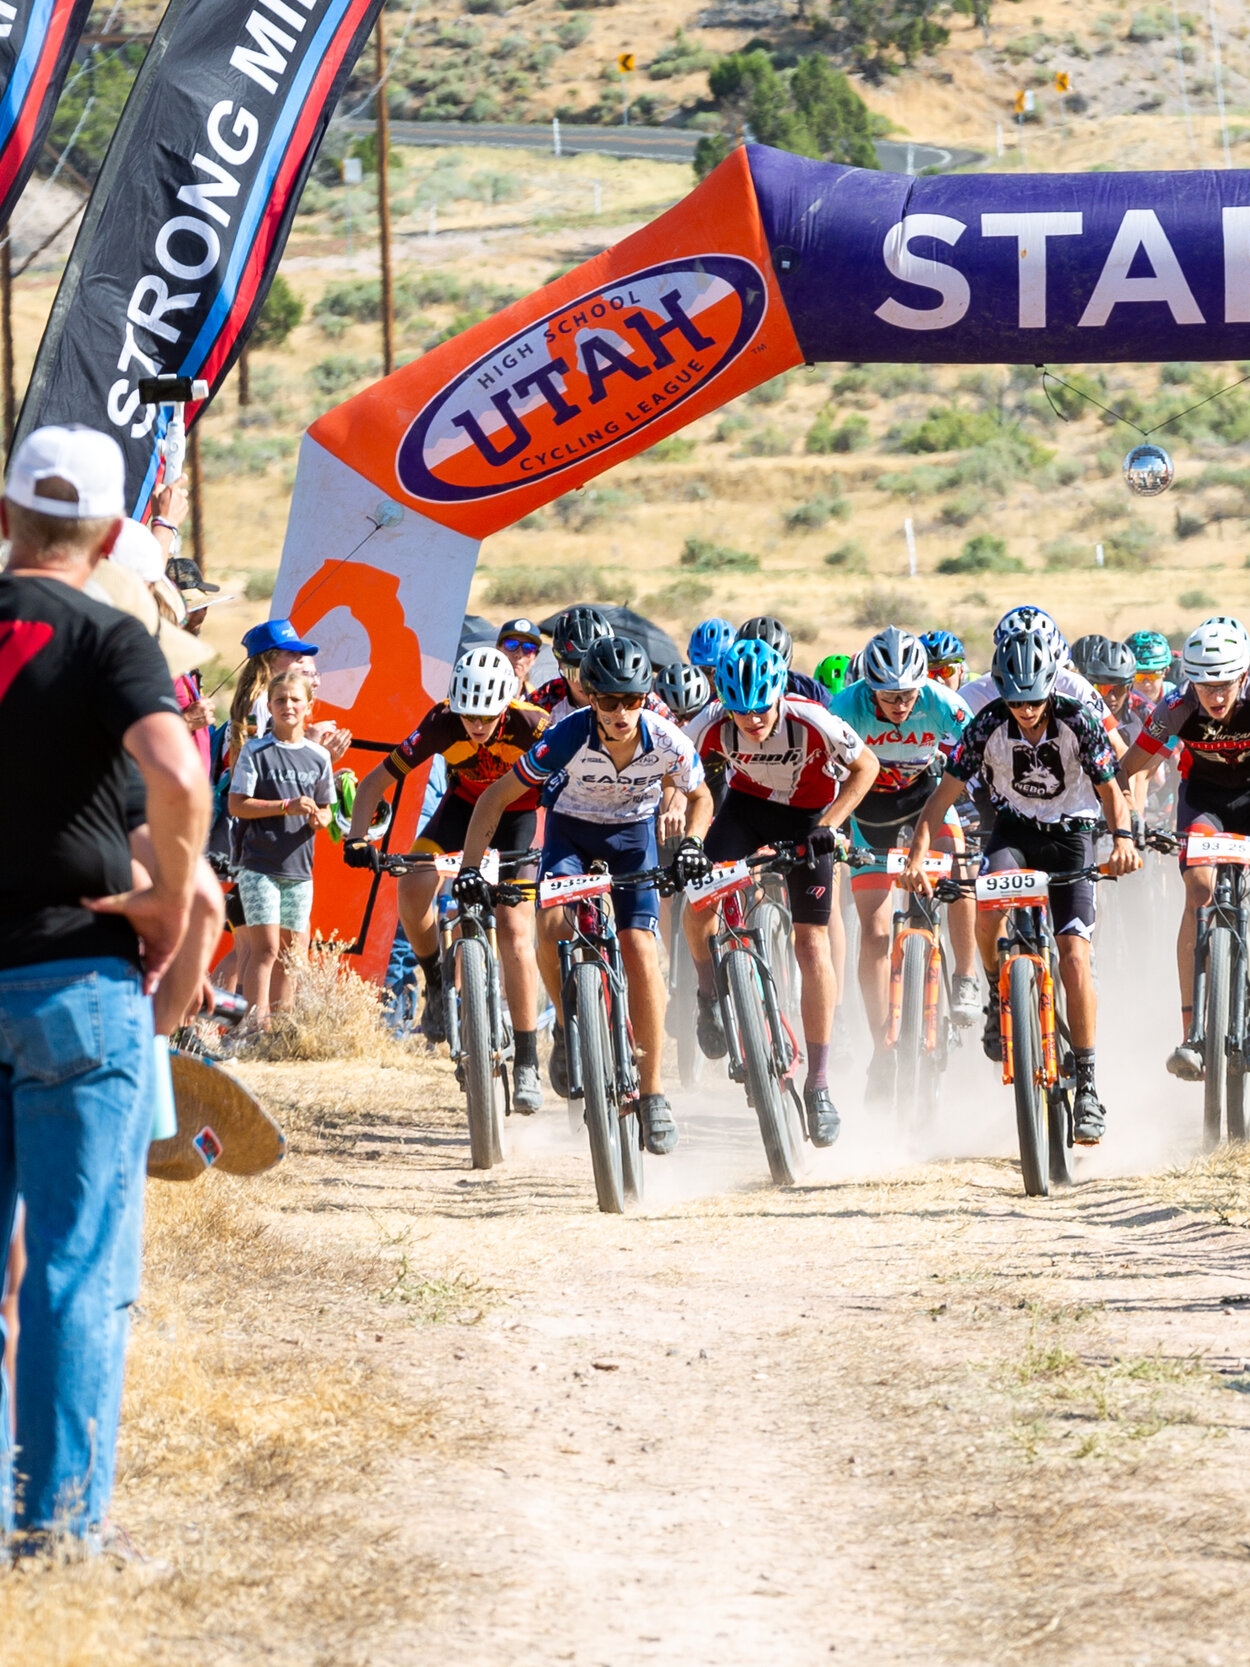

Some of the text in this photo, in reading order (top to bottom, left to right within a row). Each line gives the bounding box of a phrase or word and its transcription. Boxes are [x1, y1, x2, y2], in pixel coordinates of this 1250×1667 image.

[108, 0, 317, 439] STRONG MI
[477, 290, 641, 389] HIGH SCHOOL
[751, 344, 768, 356] TM
[451, 288, 716, 467] UTAH
[520, 358, 705, 471] CYCLING LEAGUE
[865, 729, 936, 746] MOAB
[1013, 781, 1047, 796] NEBO
[986, 874, 1036, 891] 9305
